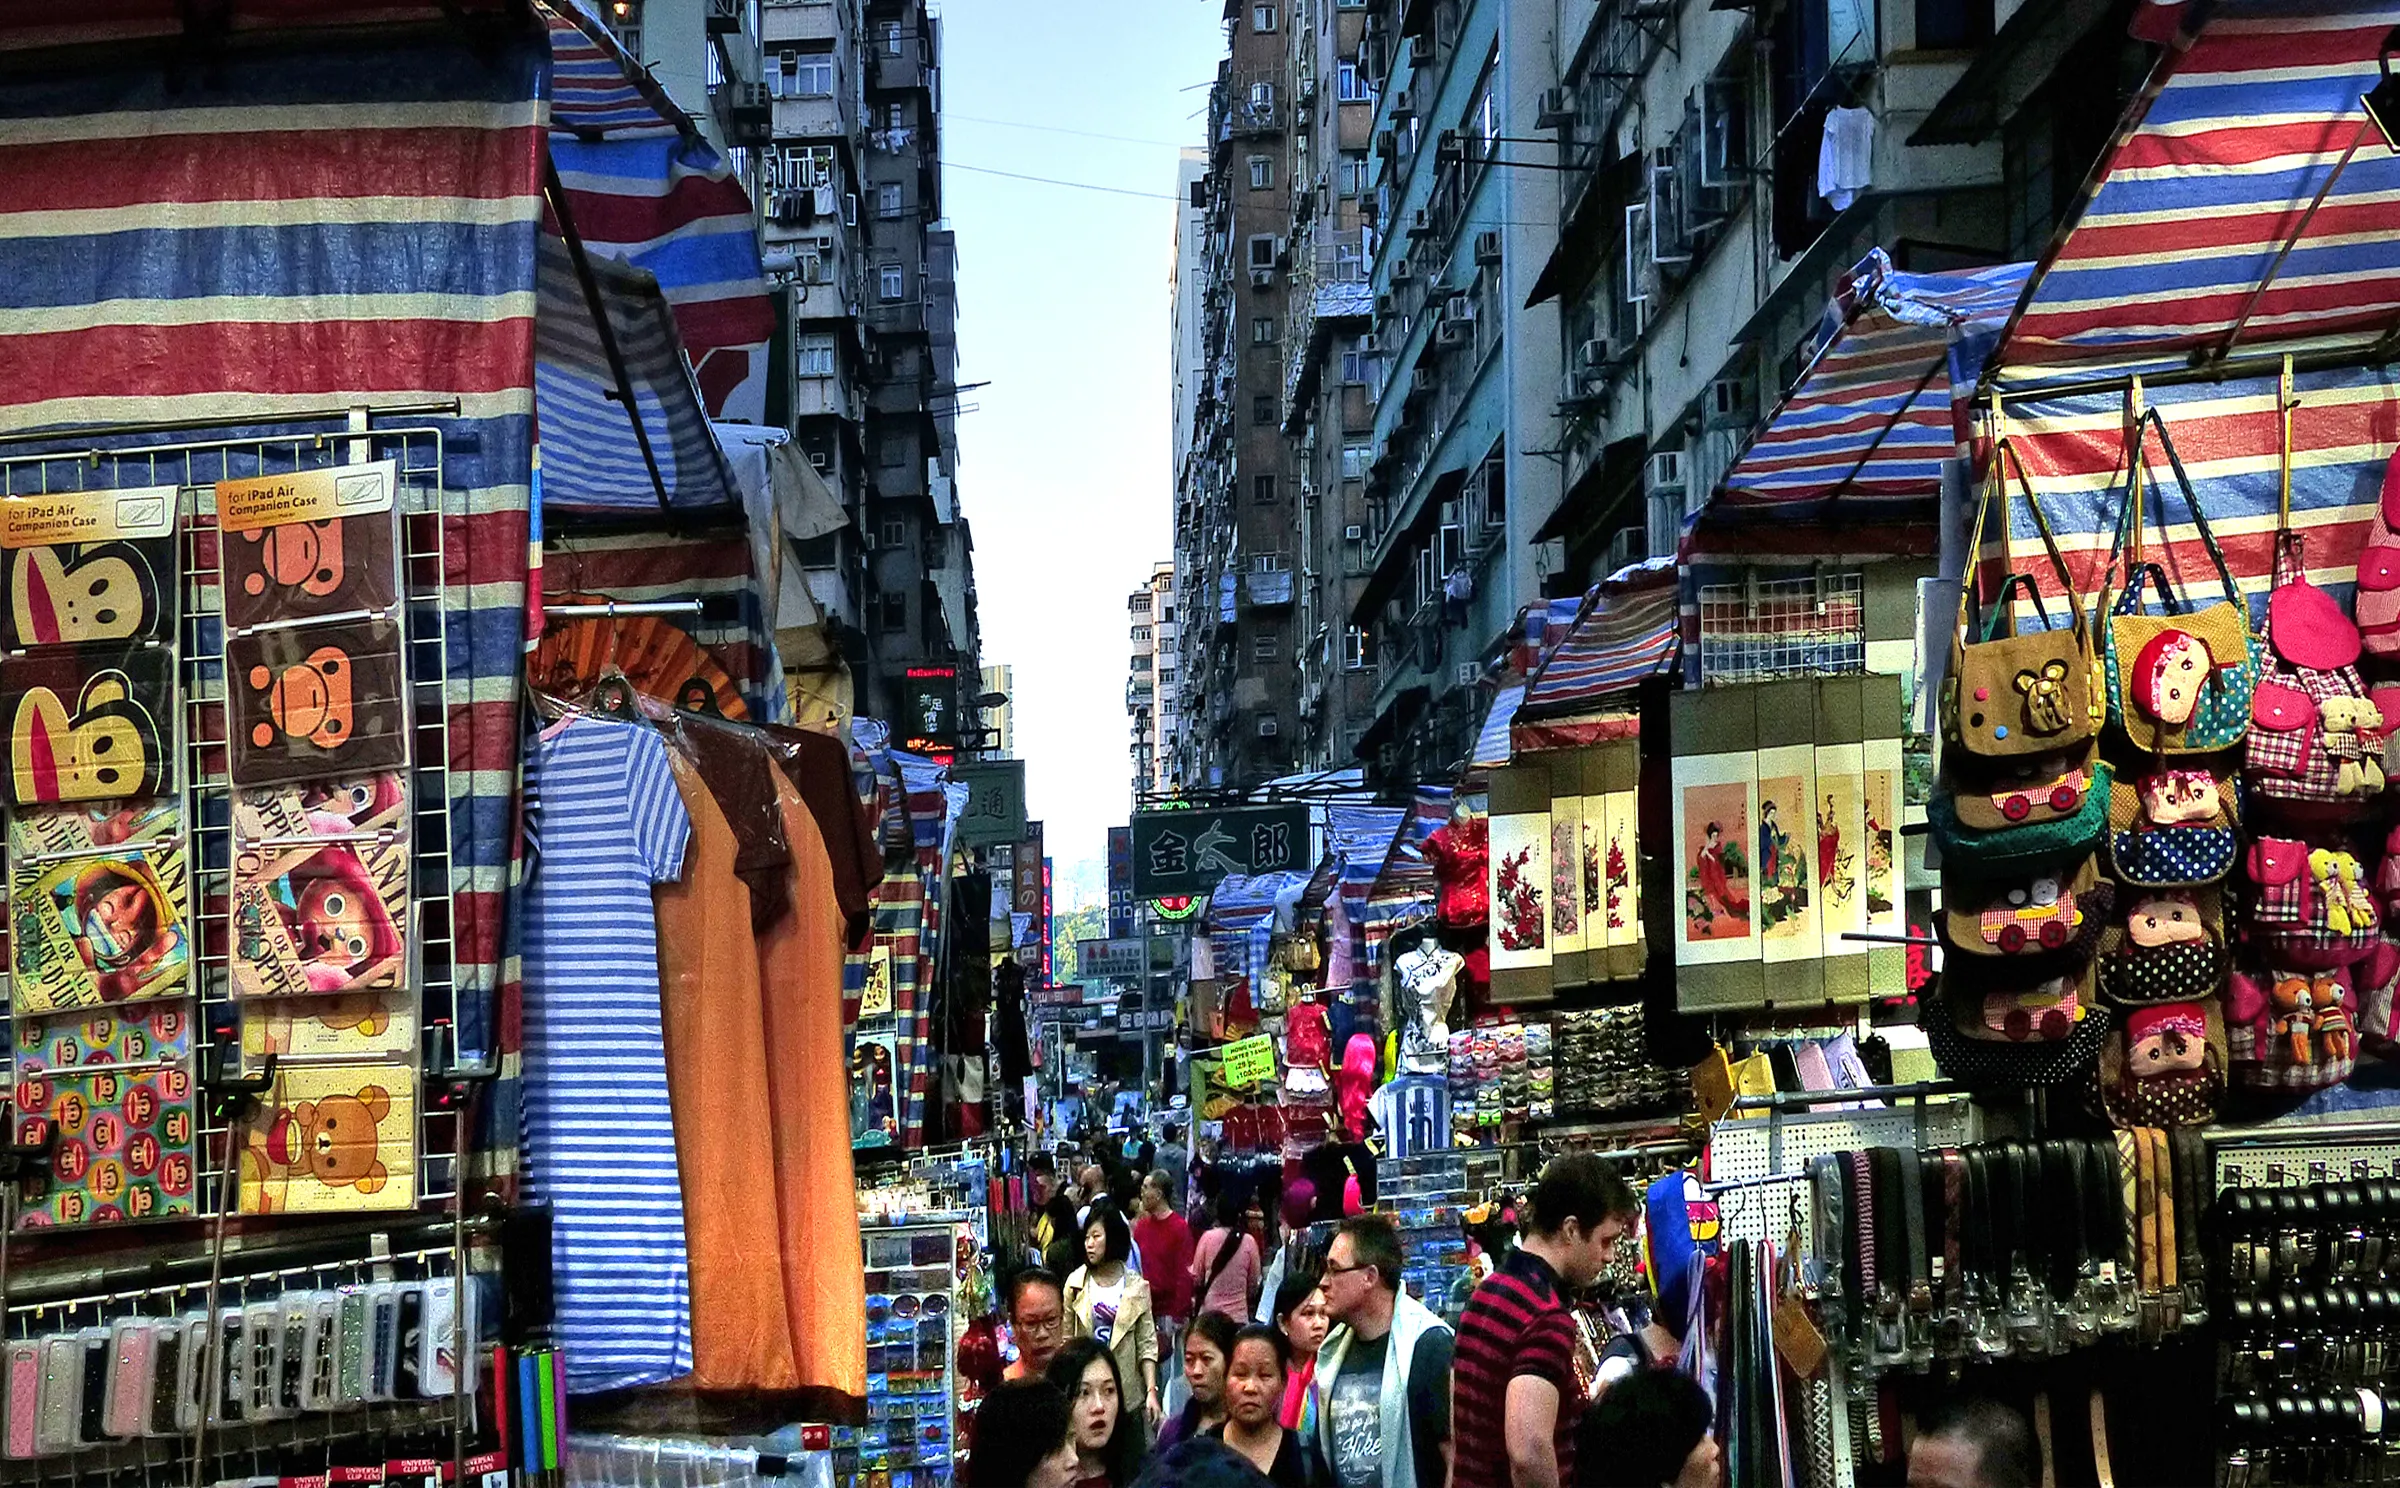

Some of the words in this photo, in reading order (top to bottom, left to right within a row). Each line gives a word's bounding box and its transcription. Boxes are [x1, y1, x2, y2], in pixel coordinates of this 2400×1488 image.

[228, 491, 244, 503] for
[247, 488, 274, 501] iPad
[276, 486, 295, 498] Air
[8, 509, 24, 520] for
[27, 506, 54, 518] iPad
[56, 504, 76, 516] Air
[229, 500, 290, 517] Companion
[292, 496, 318, 507] Case
[8, 520, 69, 534] Companion
[72, 516, 97, 527] Case
[1028, 825, 1041, 836] 27
[1149, 819, 1291, 876] 金太郎
[36, 894, 62, 935] DEAD
[59, 942, 75, 963] OR
[273, 934, 289, 954] OR
[347, 1473, 362, 1481] CLIP
[403, 1465, 418, 1473] CLIP
[294, 1475, 326, 1484] UNIVERS
